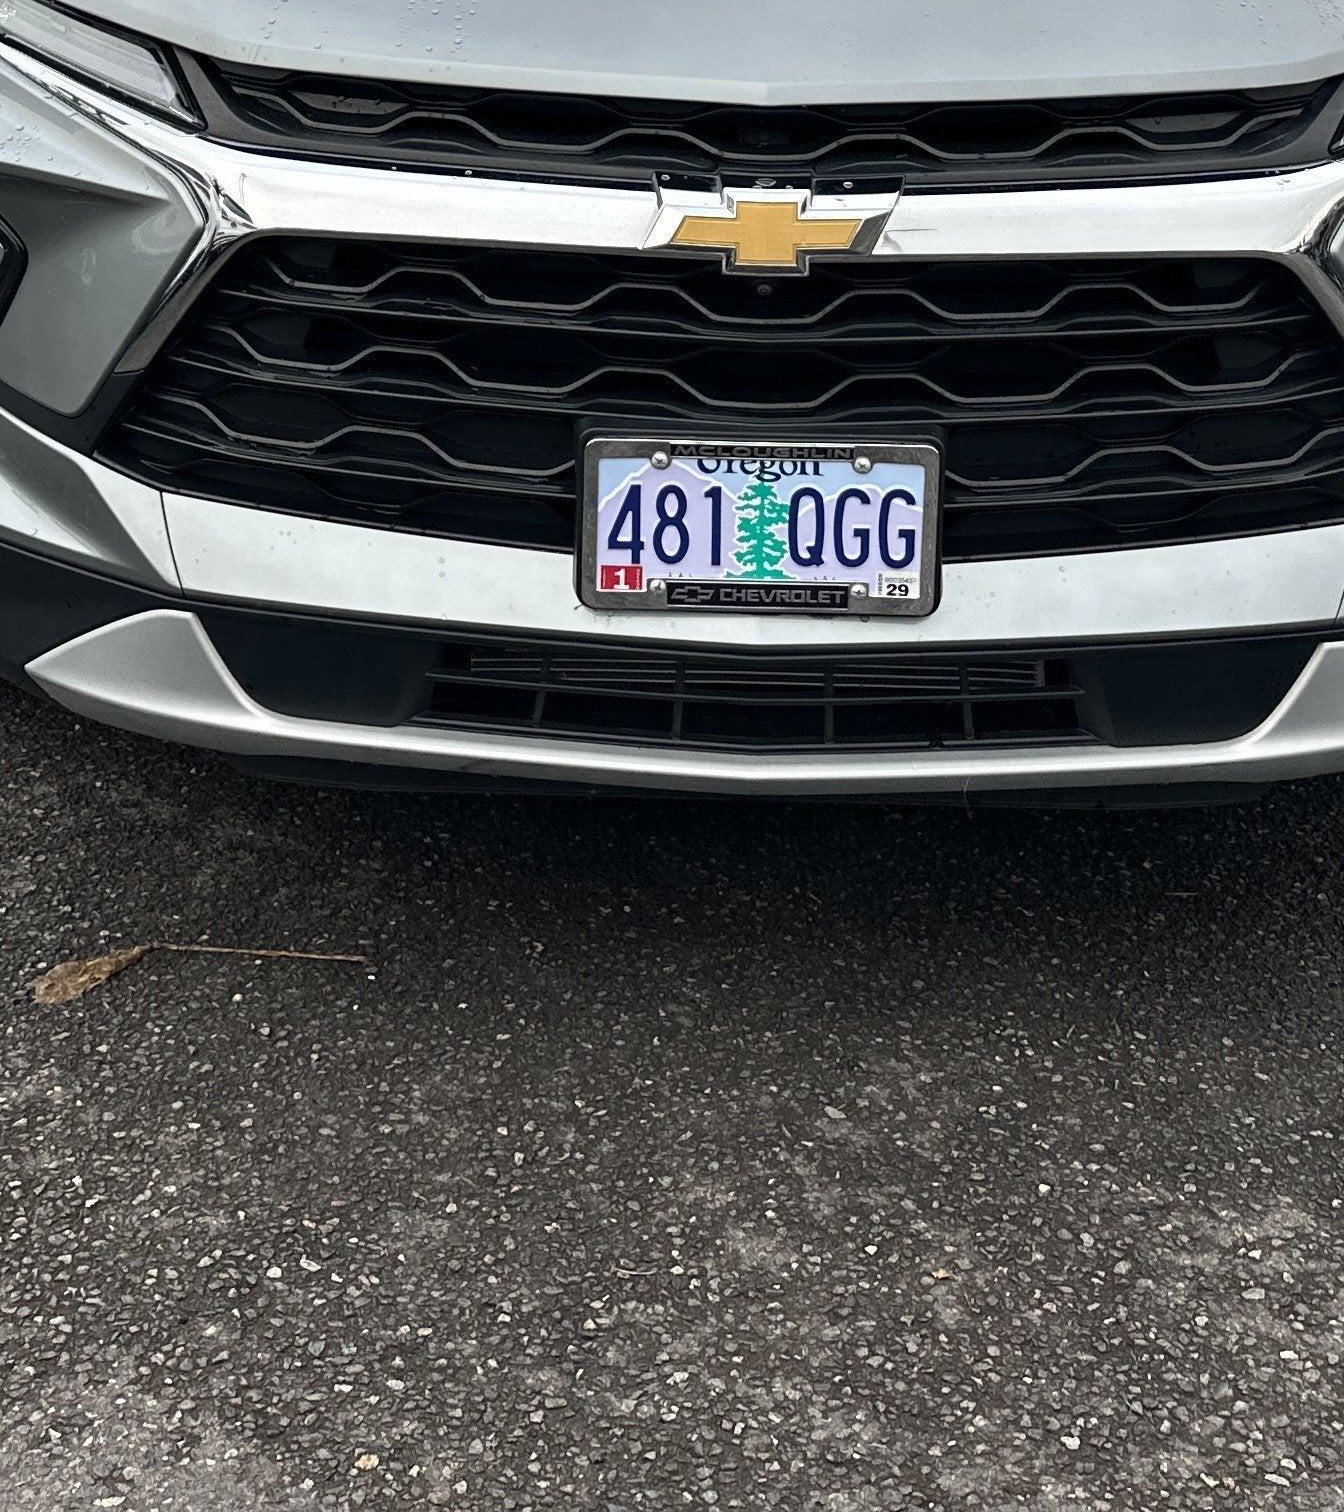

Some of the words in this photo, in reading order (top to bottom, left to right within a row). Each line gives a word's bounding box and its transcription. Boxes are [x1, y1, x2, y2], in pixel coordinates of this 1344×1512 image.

[675, 445, 851, 459] MCLOUGHLIN
[697, 458, 823, 482] Oregon
[607, 483, 723, 566] 481
[787, 486, 917, 569] QGG
[613, 568, 631, 590] 1
[719, 588, 846, 604] CHEVROLET
[886, 583, 910, 597] 29
